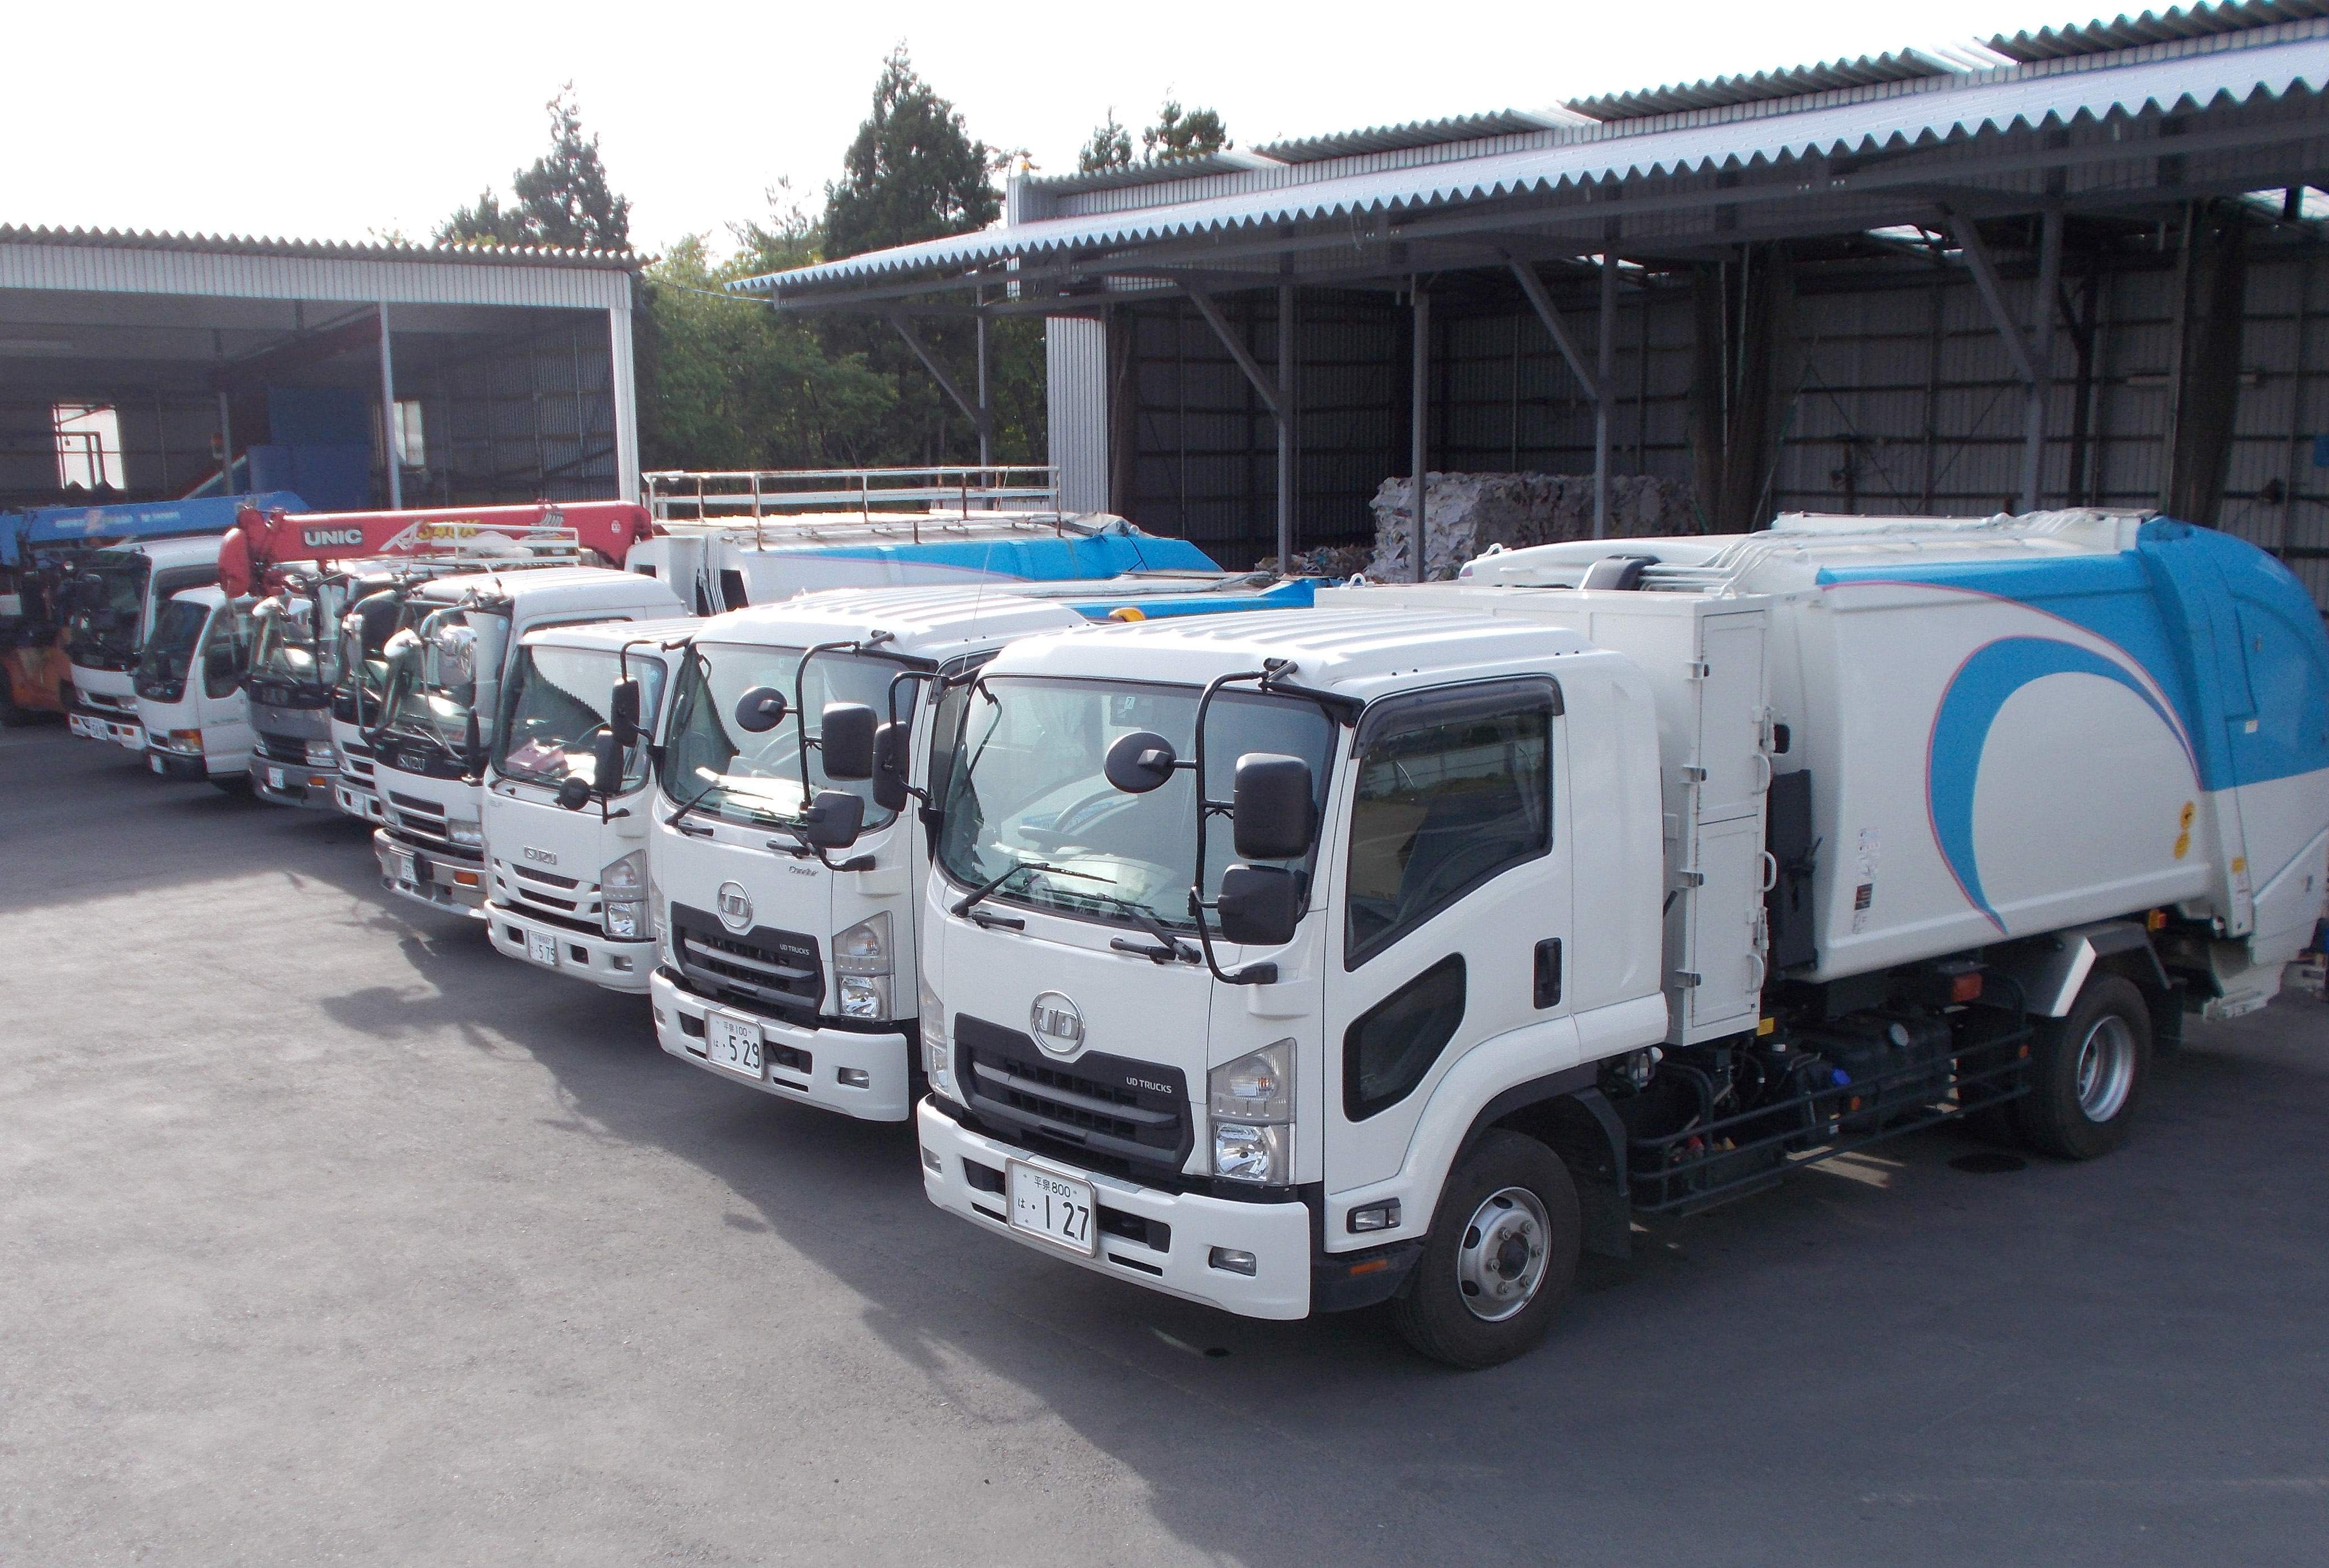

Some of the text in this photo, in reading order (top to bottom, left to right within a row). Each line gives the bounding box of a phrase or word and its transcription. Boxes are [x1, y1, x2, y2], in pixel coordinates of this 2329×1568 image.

[304, 529, 363, 546] UNIC
[524, 846, 558, 865] ISUZU
[788, 945, 810, 955] TRUCKS
[1034, 1004, 1080, 1040] UD
[1126, 1076, 1172, 1094] UD TRUCKS
[1034, 1175, 1071, 1198] 平泉800
[1018, 1197, 1026, 1209] は
